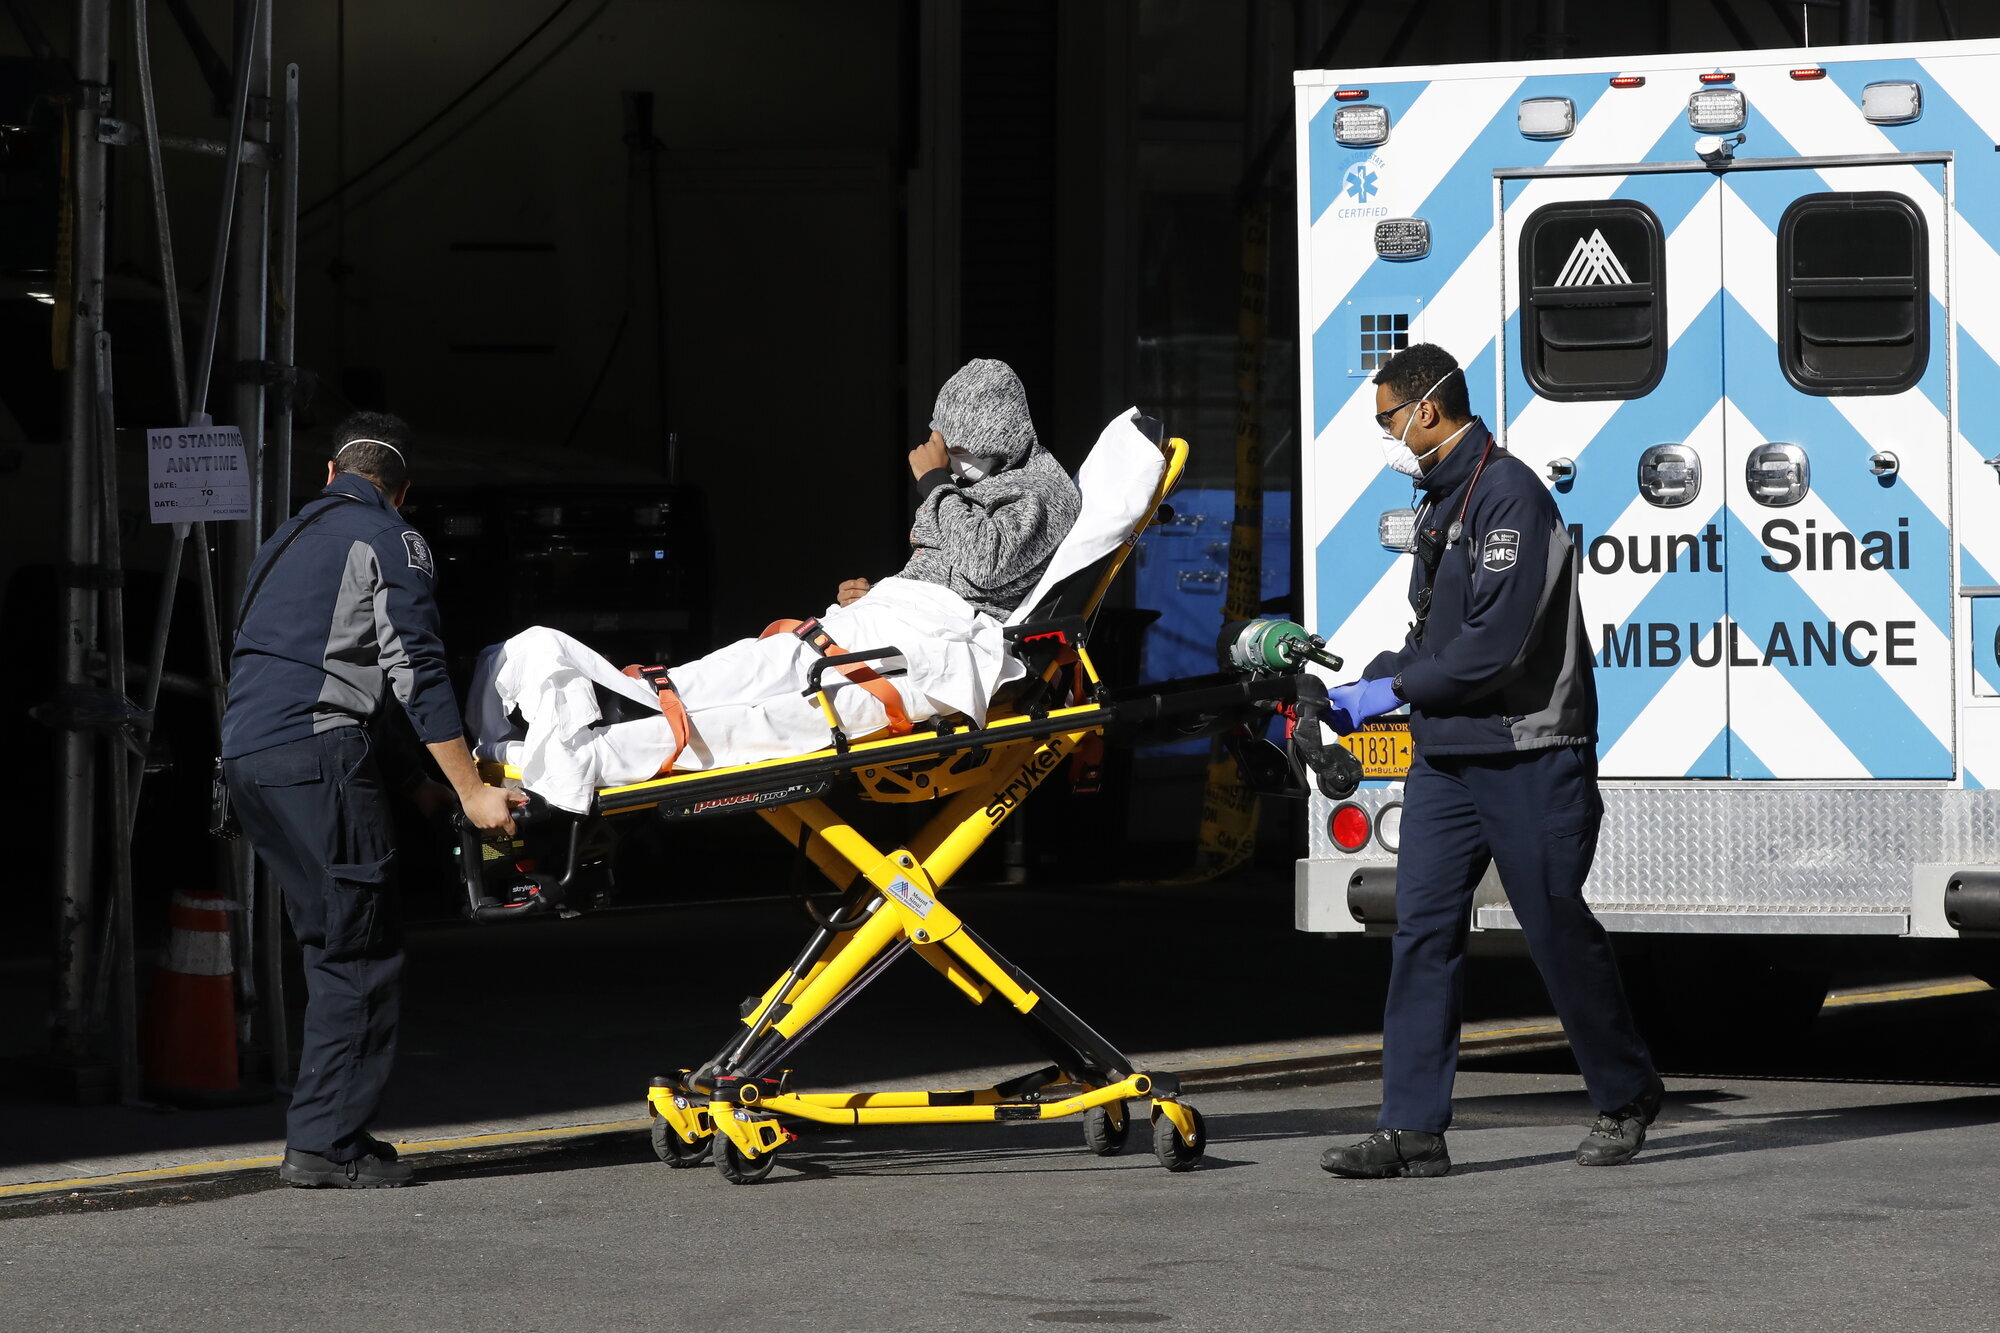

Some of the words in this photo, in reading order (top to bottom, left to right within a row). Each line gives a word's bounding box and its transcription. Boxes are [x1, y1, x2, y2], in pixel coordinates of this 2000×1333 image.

[1338, 207, 1387, 218] CERTIFIED
[152, 435, 172, 450] NO
[166, 455, 238, 473] ANYTIME
[153, 481, 177, 489] DATE:
[154, 500, 179, 508] DATE:
[1760, 517, 1910, 573] Sinai
[1485, 547, 1516, 563] EMS
[1590, 620, 1918, 668] MBULANCE
[1363, 723, 1387, 732] NEW
[1388, 723, 1409, 732] YOR
[1348, 736, 1396, 766] 11831
[909, 896, 923, 909] Sinai
[912, 891, 929, 907] Mount
